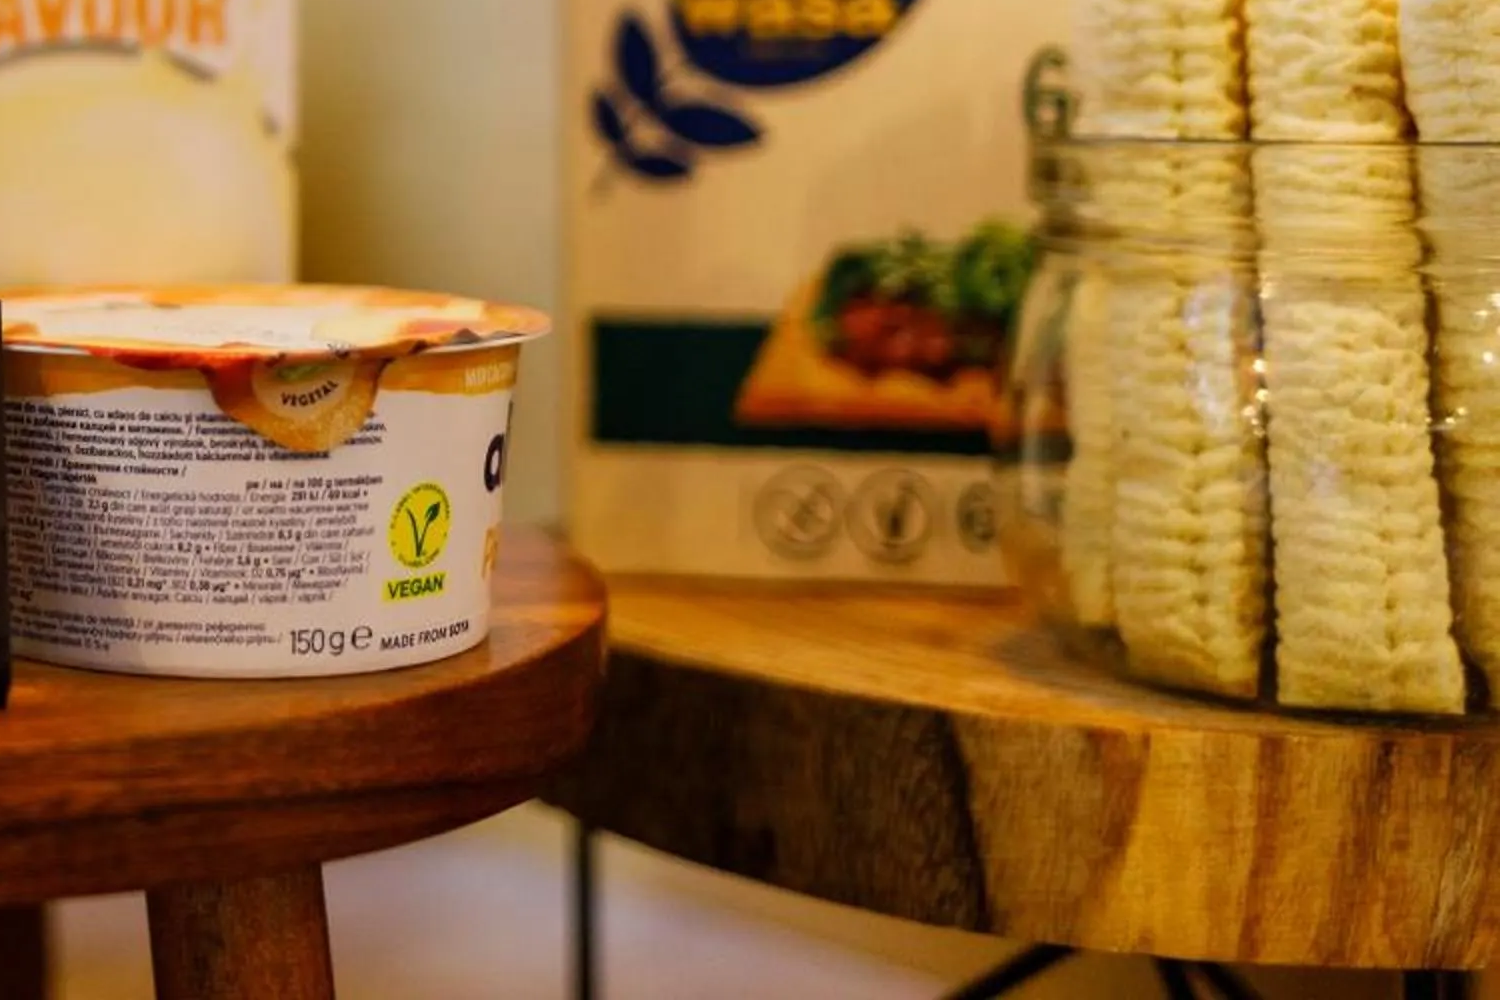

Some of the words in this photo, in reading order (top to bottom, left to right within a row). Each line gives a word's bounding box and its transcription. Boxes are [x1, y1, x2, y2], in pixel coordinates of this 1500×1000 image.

[387, 576, 445, 600] VEGAN
[289, 628, 325, 656] 150
[328, 631, 346, 657] g
[379, 632, 416, 650] MADE
[417, 626, 448, 644] FROM
